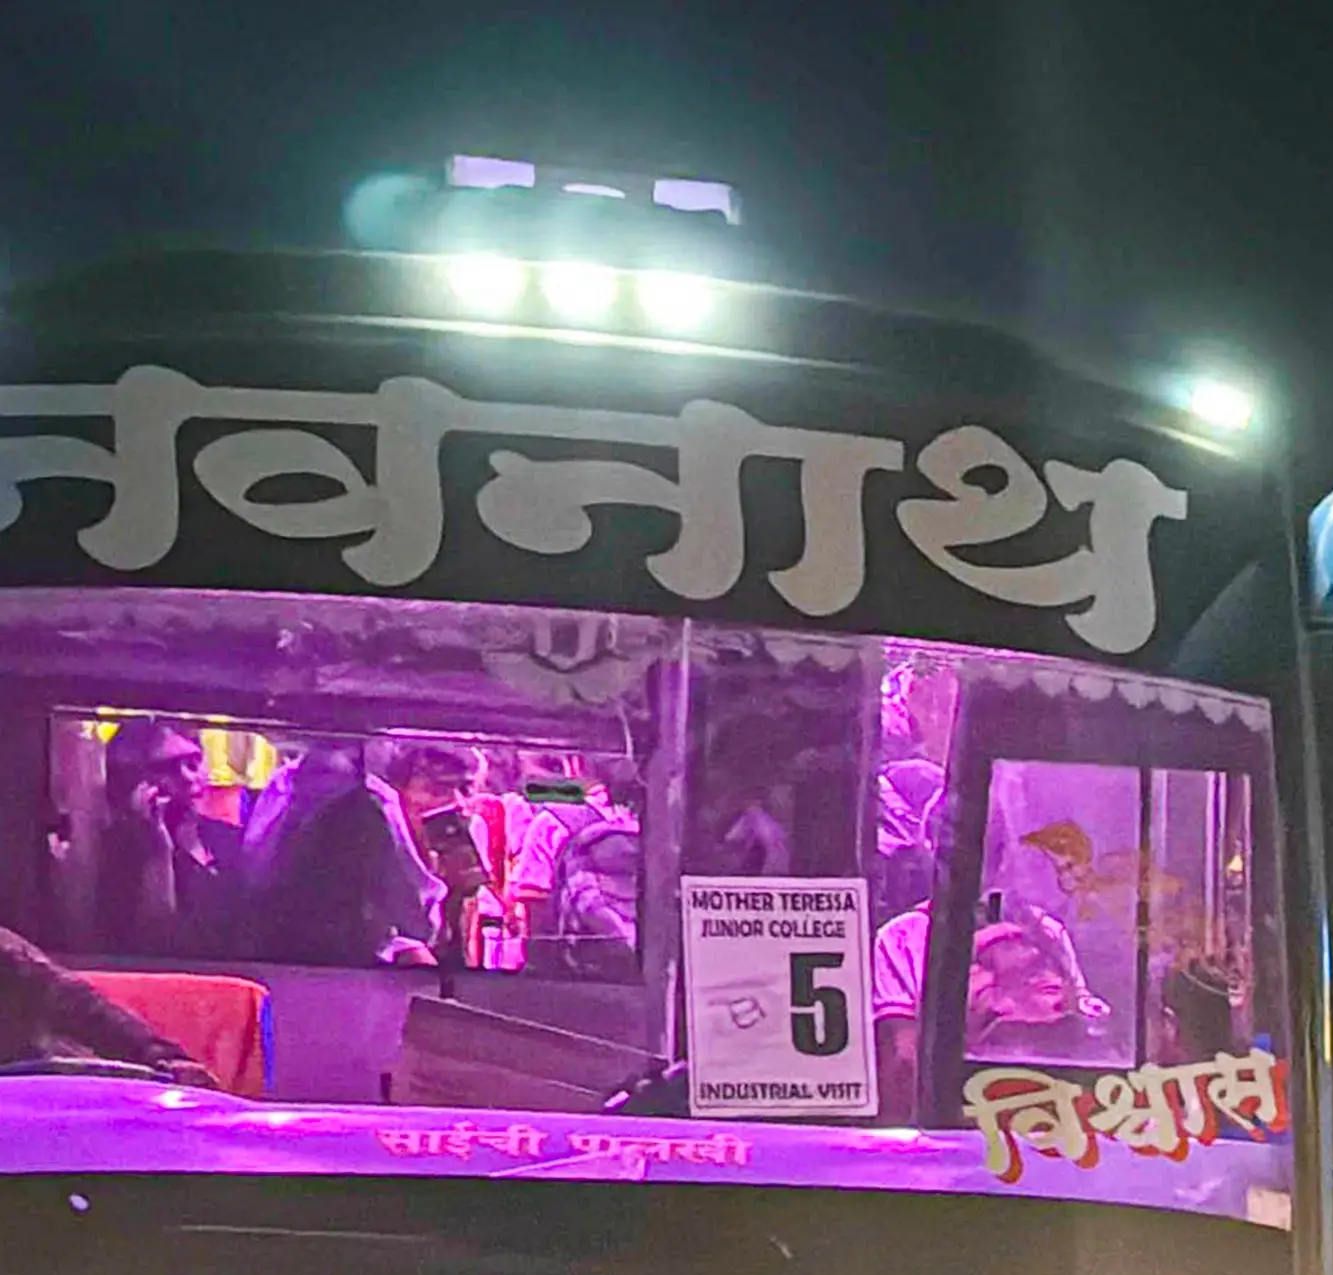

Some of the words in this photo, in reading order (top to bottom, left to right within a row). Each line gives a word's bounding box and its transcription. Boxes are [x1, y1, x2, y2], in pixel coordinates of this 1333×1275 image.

[692, 890, 774, 911] MOTHER
[778, 892, 857, 912] TERESSA
[701, 919, 764, 938] JUNIOR
[769, 920, 846, 938] COLLEGE
[789, 951, 849, 1057] 5
[699, 1082, 813, 1100] INDUSTRIAL
[817, 1082, 863, 1100] VISIT
